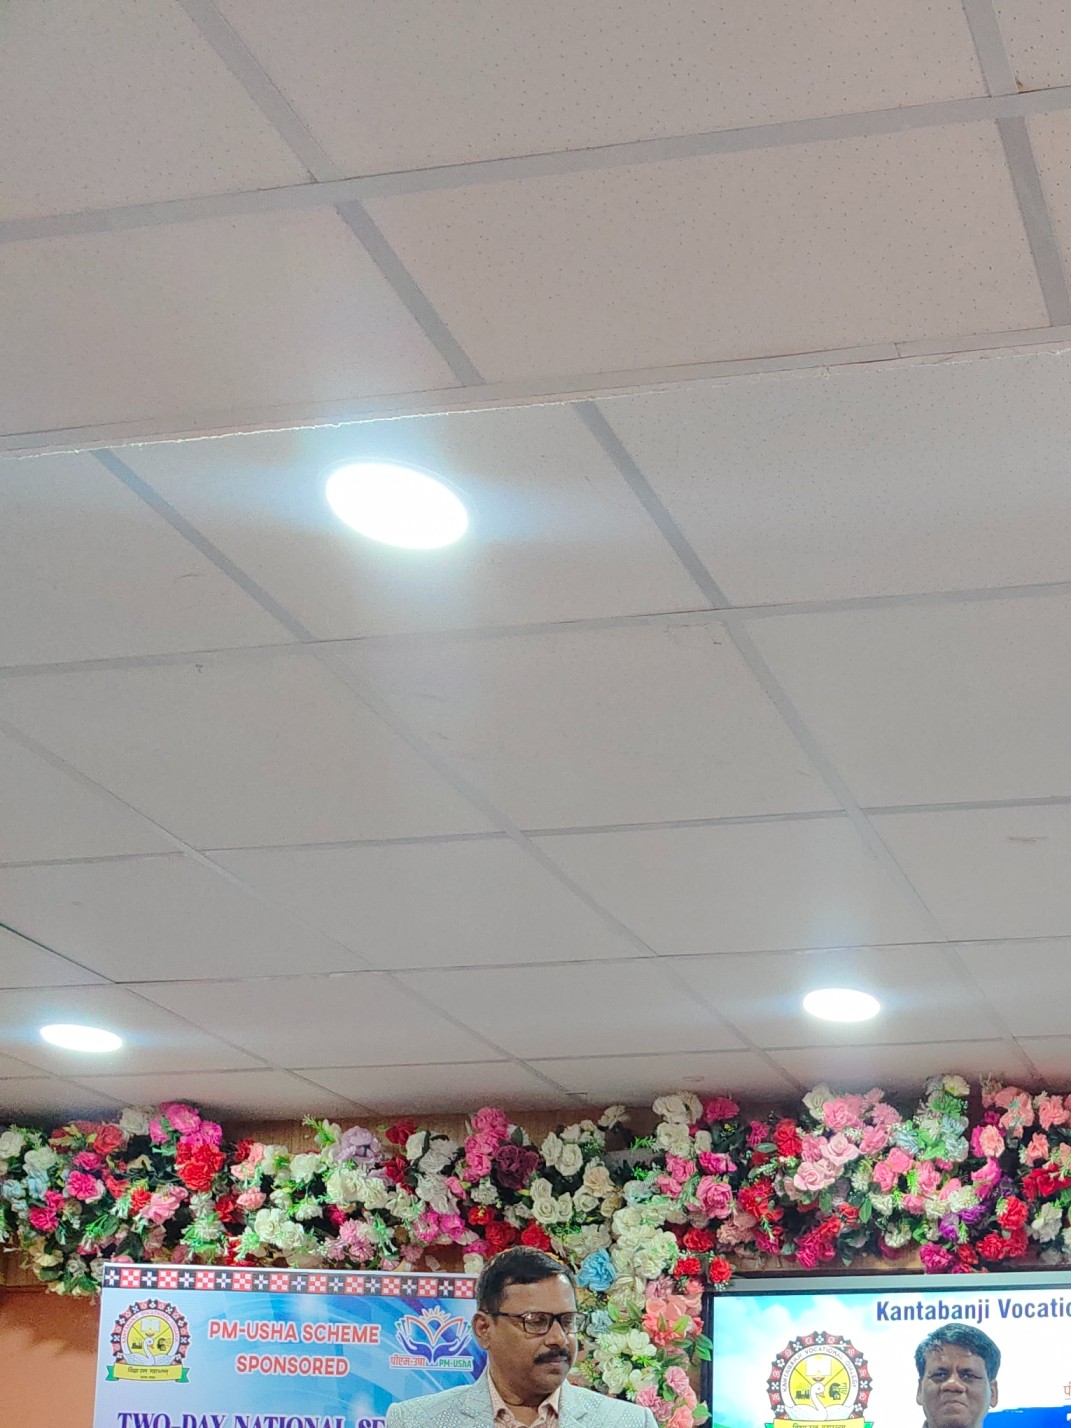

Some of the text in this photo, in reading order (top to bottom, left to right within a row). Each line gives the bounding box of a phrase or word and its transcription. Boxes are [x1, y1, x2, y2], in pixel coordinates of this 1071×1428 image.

[876, 1299, 990, 1324] Kantabanji
[209, 1320, 379, 1344] PM-USHA SCHEME
[236, 1356, 349, 1376] SPONSORED
